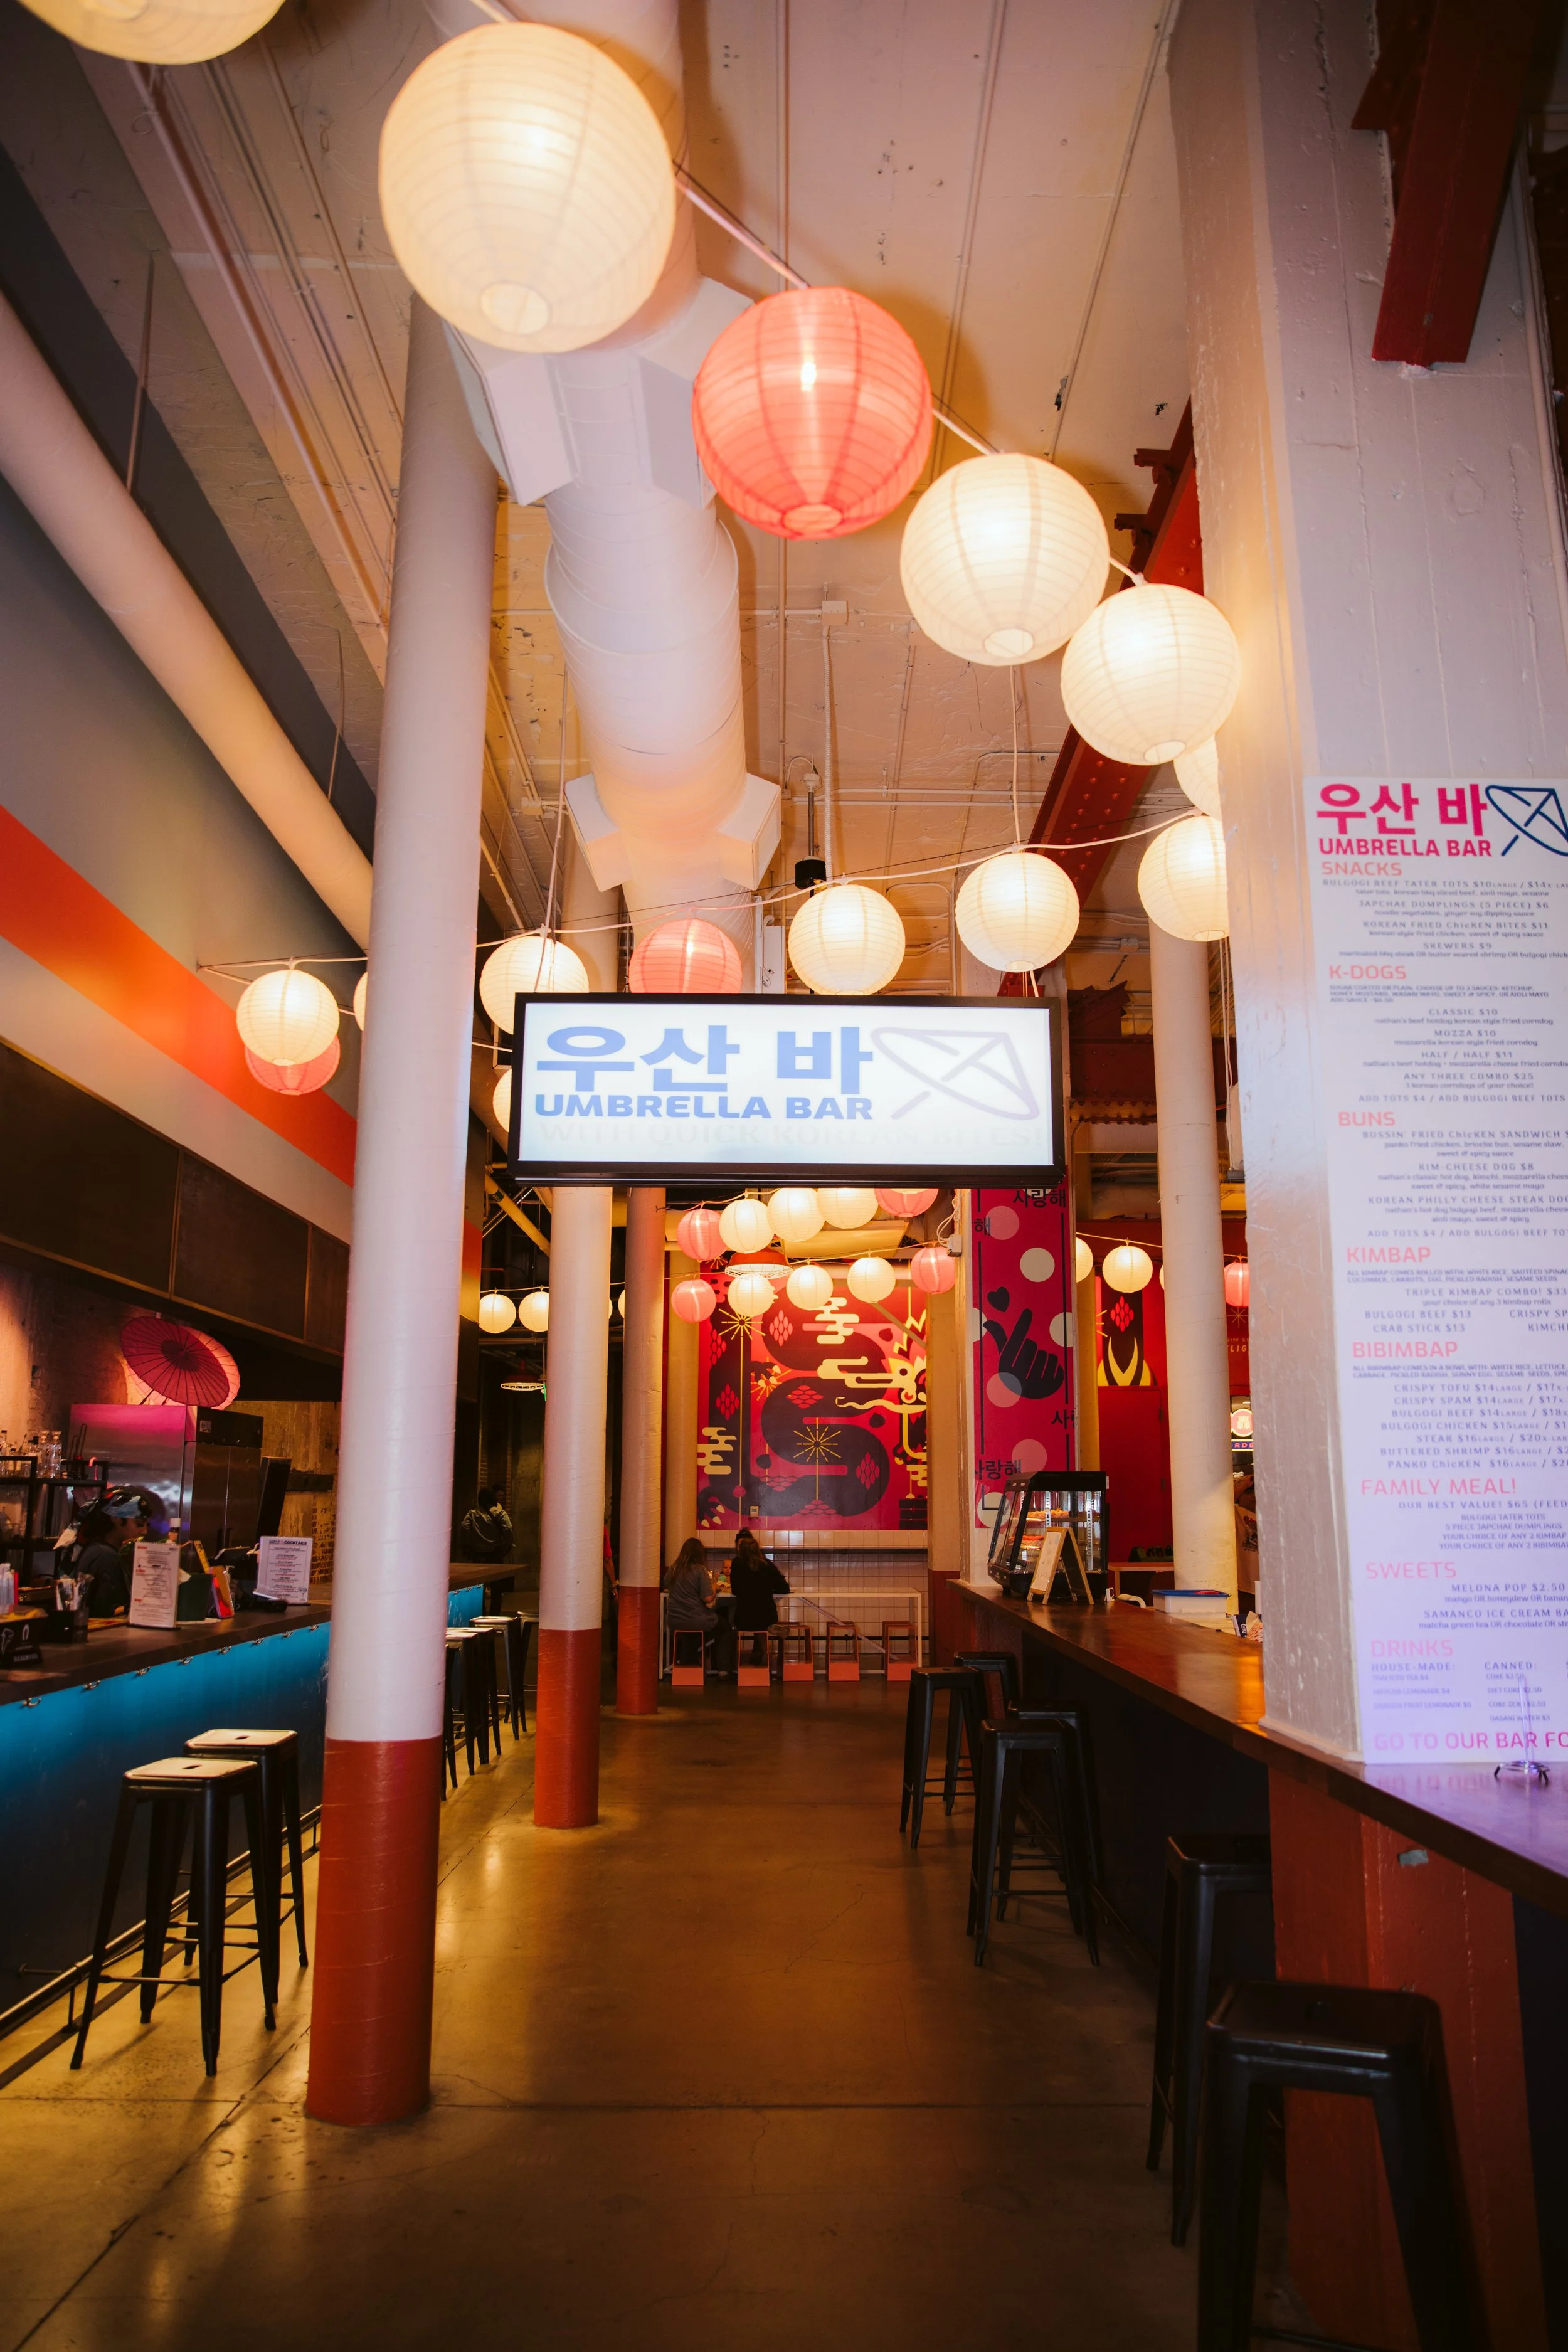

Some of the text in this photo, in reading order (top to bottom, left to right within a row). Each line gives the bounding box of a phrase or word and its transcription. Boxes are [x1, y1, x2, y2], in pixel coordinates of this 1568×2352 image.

[1316, 783, 1488, 837] 우산 바
[1318, 838, 1492, 857] UMBRELLA BAR
[1322, 861, 1402, 876] SNACKS
[1496, 901, 1531, 909] PIECE)
[1328, 965, 1407, 980] K-DOGS
[536, 1025, 874, 1095] 우산 바
[535, 1094, 874, 1120] UMBRELLA BAR
[1338, 1111, 1396, 1126] BUNS
[539, 1123, 635, 1145] WITH
[647, 1123, 763, 1147] QUICK
[772, 1123, 921, 1147] KOREAN
[1493, 1163, 1517, 1171] DOG
[1520, 1163, 1534, 1171] $8
[1013, 1189, 1066, 1208] 사랑해
[1368, 1196, 1414, 1204] KOREAN
[1418, 1196, 1457, 1204] PHILLY
[1461, 1195, 1505, 1204] CHEESE
[1509, 1195, 1545, 1204] STEAK
[972, 1216, 991, 1236] 해
[1347, 1246, 1431, 1264] KIMBAP
[1405, 1288, 1444, 1296] TRIPLE
[1448, 1288, 1493, 1296] KIMBAP
[1365, 1309, 1550, 1319] BULGOGI BEEF $13 CRISPY
[1372, 1324, 1403, 1333] CRAB
[1407, 1324, 1441, 1333] STICK
[1445, 1323, 1465, 1333] $13
[1352, 1341, 1458, 1358] BIBIMBAP
[1394, 1384, 1470, 1392] CRISPY TOFU
[1394, 1397, 1436, 1405] CRISPY
[1391, 1409, 1475, 1417] BULGOGI BEEF
[1380, 1422, 1432, 1430] BULGOGI
[1416, 1434, 1453, 1443] STEAK
[1380, 1446, 1490, 1456] BUTTERED SHRIMP
[1387, 1460, 1427, 1469] PANKO
[1361, 1478, 1516, 1495] FAMILY MEAL!
[1398, 1501, 1423, 1509] OUR
[1427, 1501, 1455, 1509] BEST
[1460, 1500, 1502, 1509] VALUE!
[1507, 1500, 1528, 1508] $65
[1365, 1561, 1457, 1579] SWEETS
[1451, 1582, 1565, 1592] MELONA POP $2.50
[1486, 1594, 1529, 1603] honeydew
[1530, 1594, 1542, 1602] OR
[1424, 1609, 1551, 1619] SAMANCO ICE CREAM
[1503, 1620, 1543, 1628] chocolate
[1544, 1620, 1556, 1628] OR
[1371, 1639, 1454, 1658] DRINKS
[1374, 1732, 1404, 1751] GO
[1409, 1732, 1438, 1750] TO
[1444, 1732, 1488, 1750] OUR
[1496, 1732, 1539, 1749] BAR
